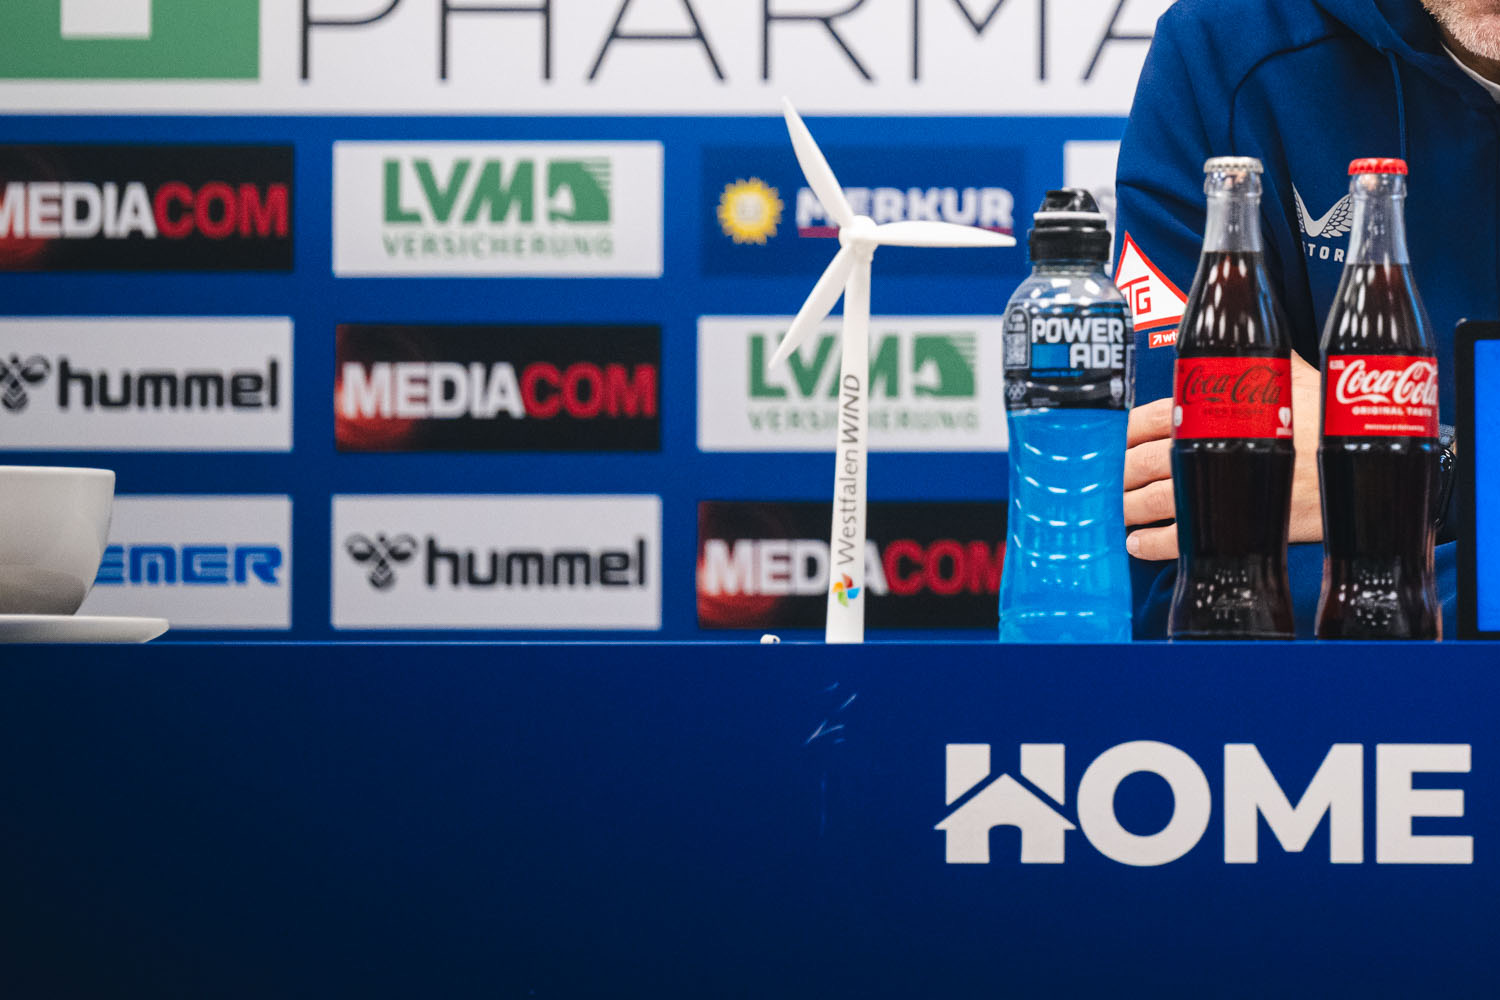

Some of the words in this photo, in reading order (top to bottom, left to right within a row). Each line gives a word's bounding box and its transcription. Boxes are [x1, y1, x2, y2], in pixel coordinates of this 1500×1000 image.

[383, 159, 534, 225] LVM
[382, 233, 613, 258] VERSICHERUNG
[1031, 318, 1124, 343] POWER
[1070, 344, 1124, 369] ADE
[1336, 359, 1438, 405] Coca-Cola
[57, 357, 279, 410] hummel
[340, 362, 655, 419] MEDIACOM
[425, 537, 646, 588] hummel
[934, 740, 1473, 866] HOME
